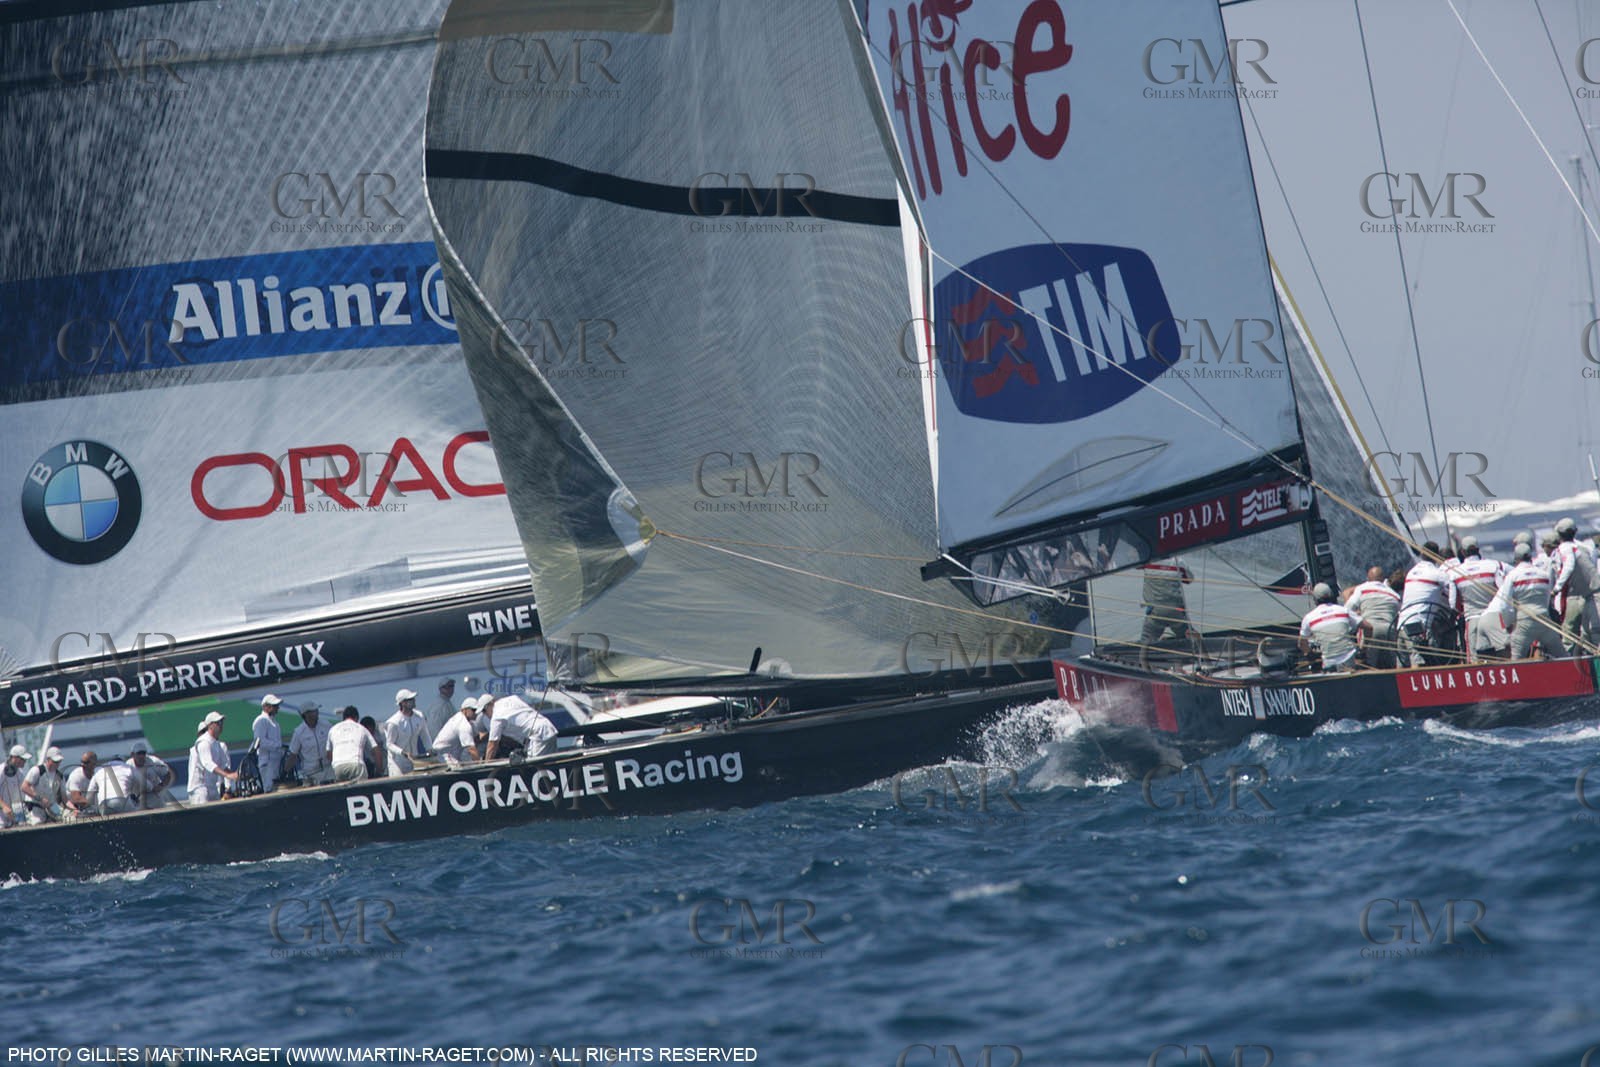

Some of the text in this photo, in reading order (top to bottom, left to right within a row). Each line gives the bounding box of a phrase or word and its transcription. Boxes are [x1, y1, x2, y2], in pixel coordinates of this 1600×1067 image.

[168, 275, 412, 343] Allianz
[1018, 262, 1147, 383] TIM
[31, 442, 130, 487] BMW
[191, 430, 508, 521] ORAC
[1159, 500, 1226, 539] PRADA
[10, 640, 330, 717] GIRARD-PERREGAUX
[1220, 688, 1253, 717] INTESA
[1263, 687, 1316, 717] SANPAOLO
[1410, 667, 1521, 692] LUNA ROSSA
[346, 749, 744, 827] BMW ORACLE Racing
